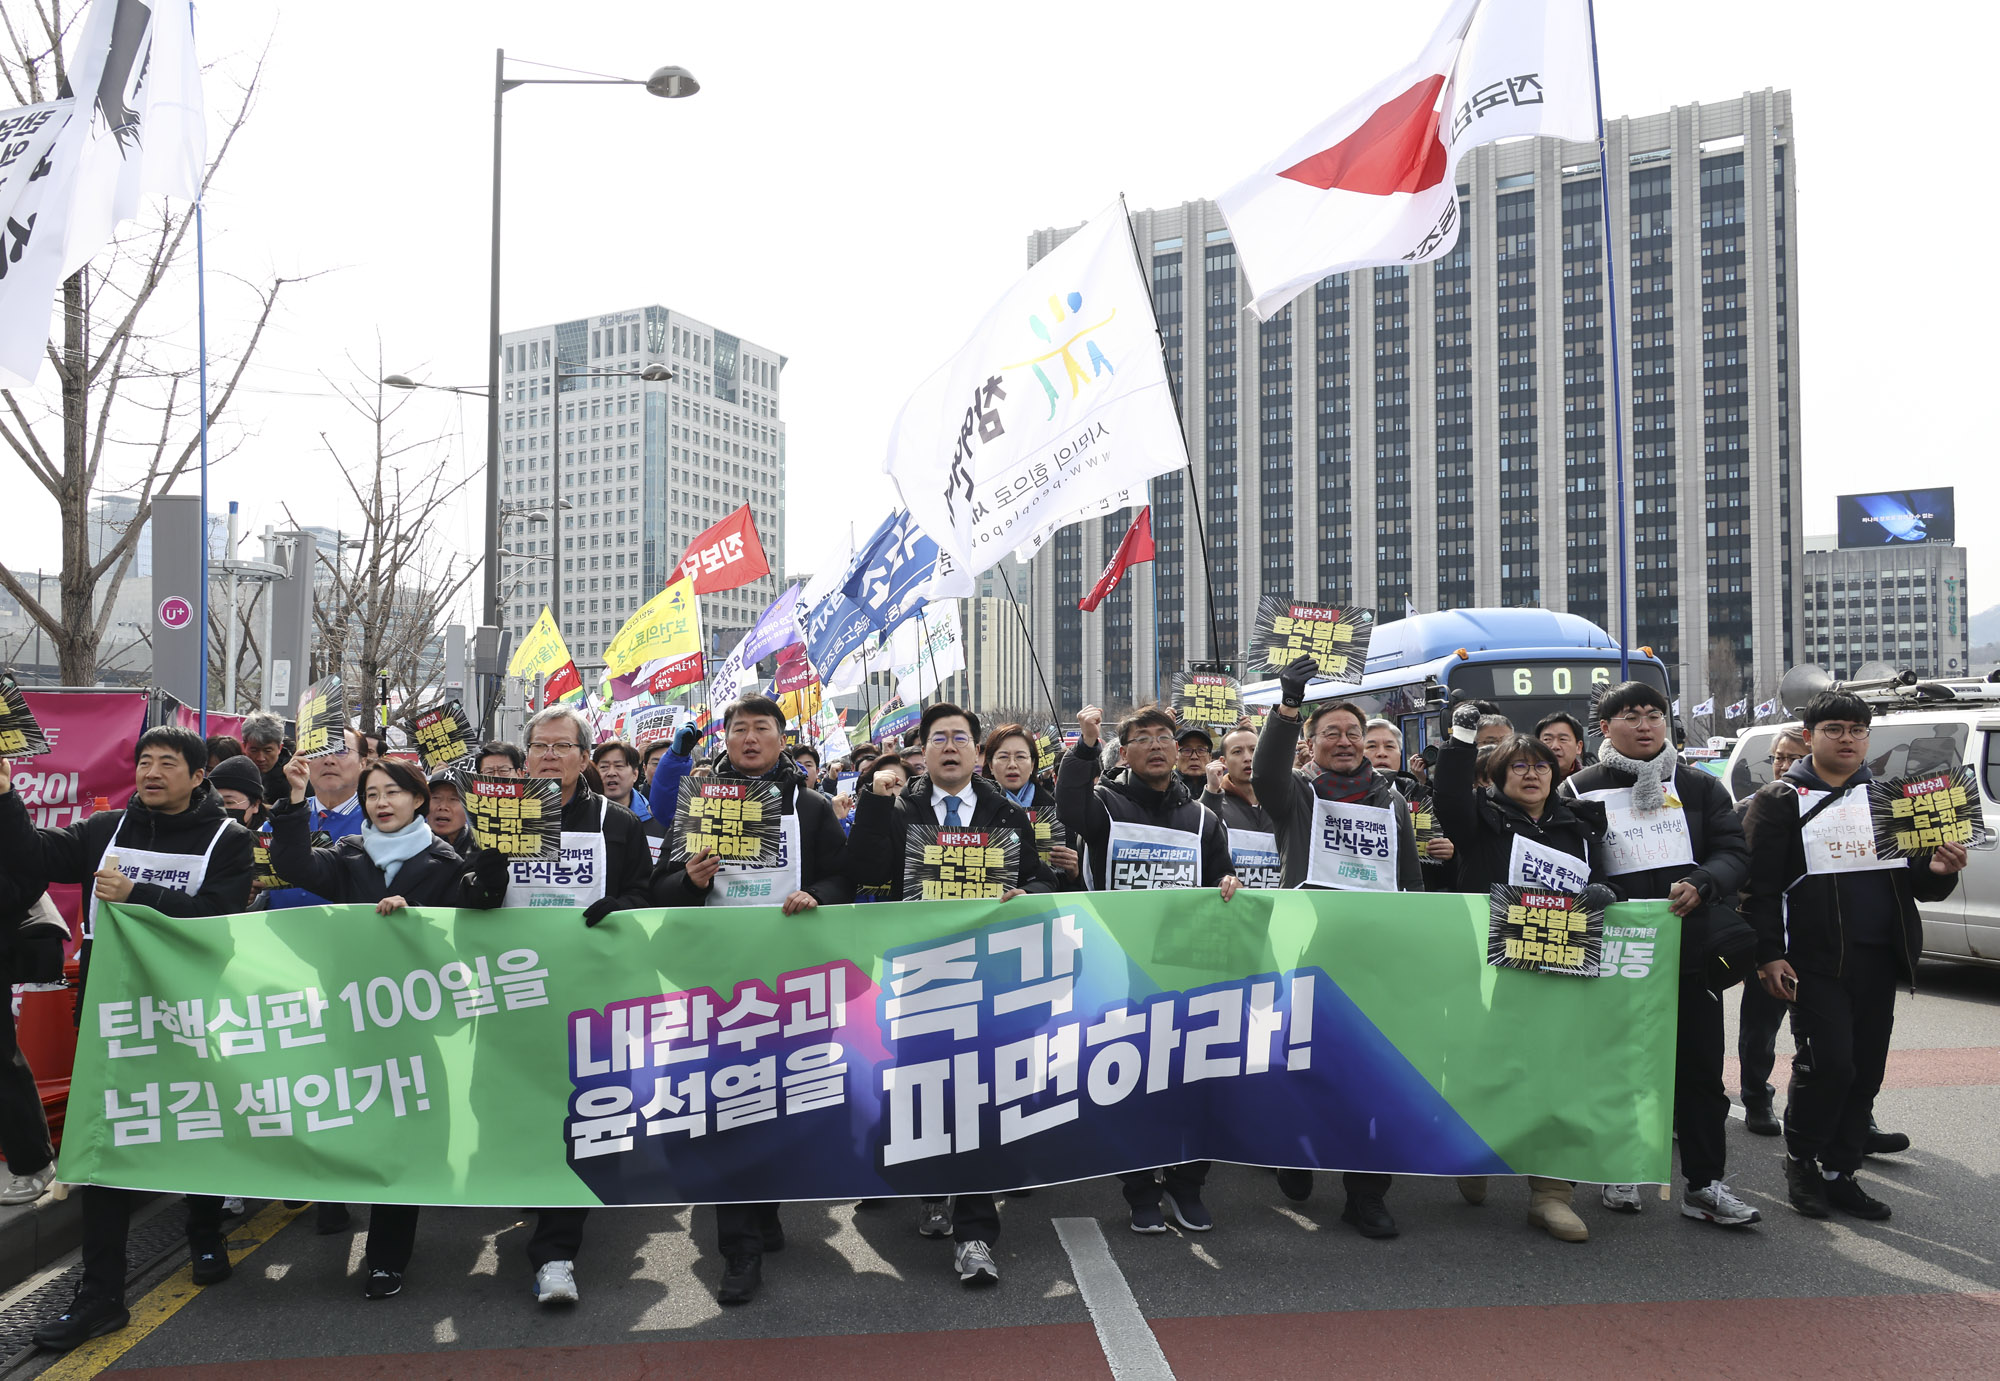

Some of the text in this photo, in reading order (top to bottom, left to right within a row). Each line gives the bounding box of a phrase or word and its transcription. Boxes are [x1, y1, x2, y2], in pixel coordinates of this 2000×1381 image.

[1294, 607, 1332, 620] 내란수괴
[1273, 616, 1354, 643] 윤석열을
[1184, 684, 1236, 700] 윤석열을
[1183, 706, 1238, 723] 파면하라
[415, 717, 458, 745] 윤석열을
[12, 772, 79, 806] 없이
[476, 783, 516, 796] 내란수괴
[704, 785, 739, 797] 내란수괴
[1907, 777, 1944, 795] 내란수괴
[465, 792, 542, 819] 윤석열을
[688, 796, 763, 821] 윤석열을
[1891, 786, 1968, 818] 윤석열을
[1325, 815, 1387, 835] 윤석열 즉각파면
[1623, 827, 1643, 840] 지역
[1651, 819, 1682, 834] 대학생
[1895, 819, 1973, 850] 파면하라
[685, 832, 762, 856] 파면하라
[942, 833, 981, 845] 내란수괴
[1323, 829, 1389, 858] 단식농성
[559, 848, 593, 861] 각파면
[924, 845, 1005, 867] 윤석열을
[1523, 851, 1554, 874] 윤석열
[141, 868, 190, 883] 즉각파면
[513, 861, 594, 885] 단식농성
[1114, 862, 1195, 890] 단식농성
[1234, 867, 1280, 888] 단식농
[1338, 865, 1378, 882] 비상행동
[726, 881, 772, 898] 비상행동
[922, 880, 1004, 900] 파면하라
[1526, 895, 1565, 908] 내란수괴
[1507, 904, 1588, 933] 윤석열을
[1603, 926, 1657, 939] 사회대개혁
[1504, 938, 1585, 966] 파면하라
[1600, 940, 1655, 979] 행동
[885, 914, 1084, 1041] 즉각
[99, 948, 549, 1059] 탄핵심판 100일을
[575, 966, 847, 1078] 내란수괴
[882, 975, 1315, 1168] 파면하라!
[104, 1055, 431, 1147] 넘길 셈인가!
[571, 1042, 848, 1160] 윤석열을
